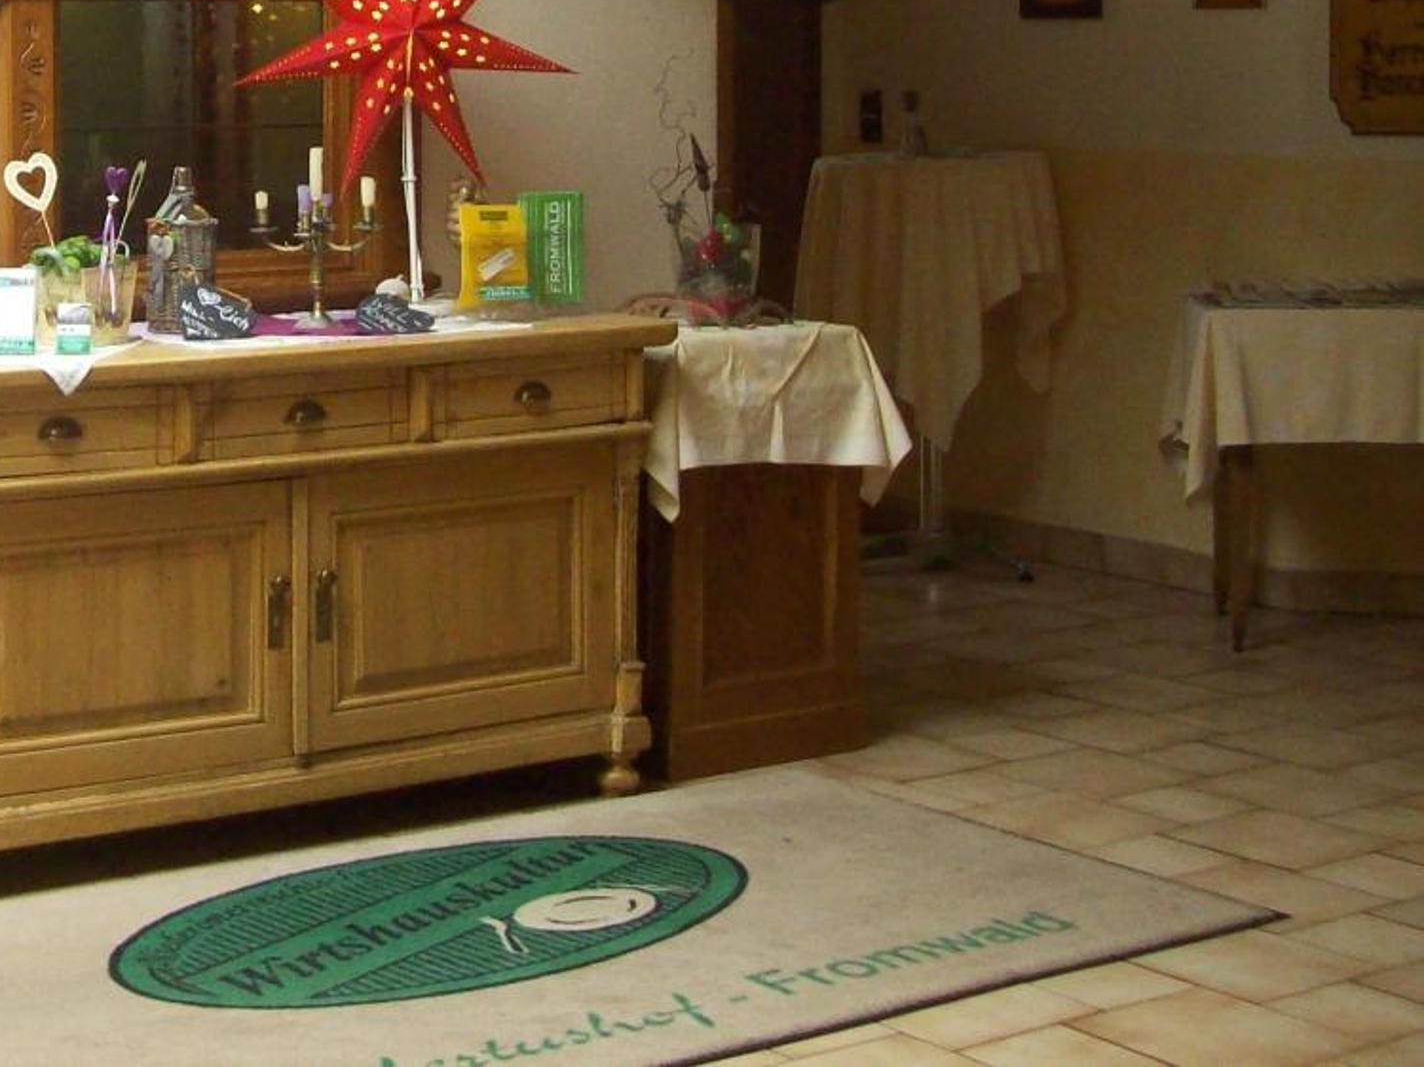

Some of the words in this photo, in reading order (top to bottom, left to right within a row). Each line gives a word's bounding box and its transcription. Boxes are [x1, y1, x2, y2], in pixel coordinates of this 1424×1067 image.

[549, 200, 562, 294] FROMWALD
[217, 840, 597, 997] Wirtshauskultur
[745, 908, 1077, 997] Fromwald
